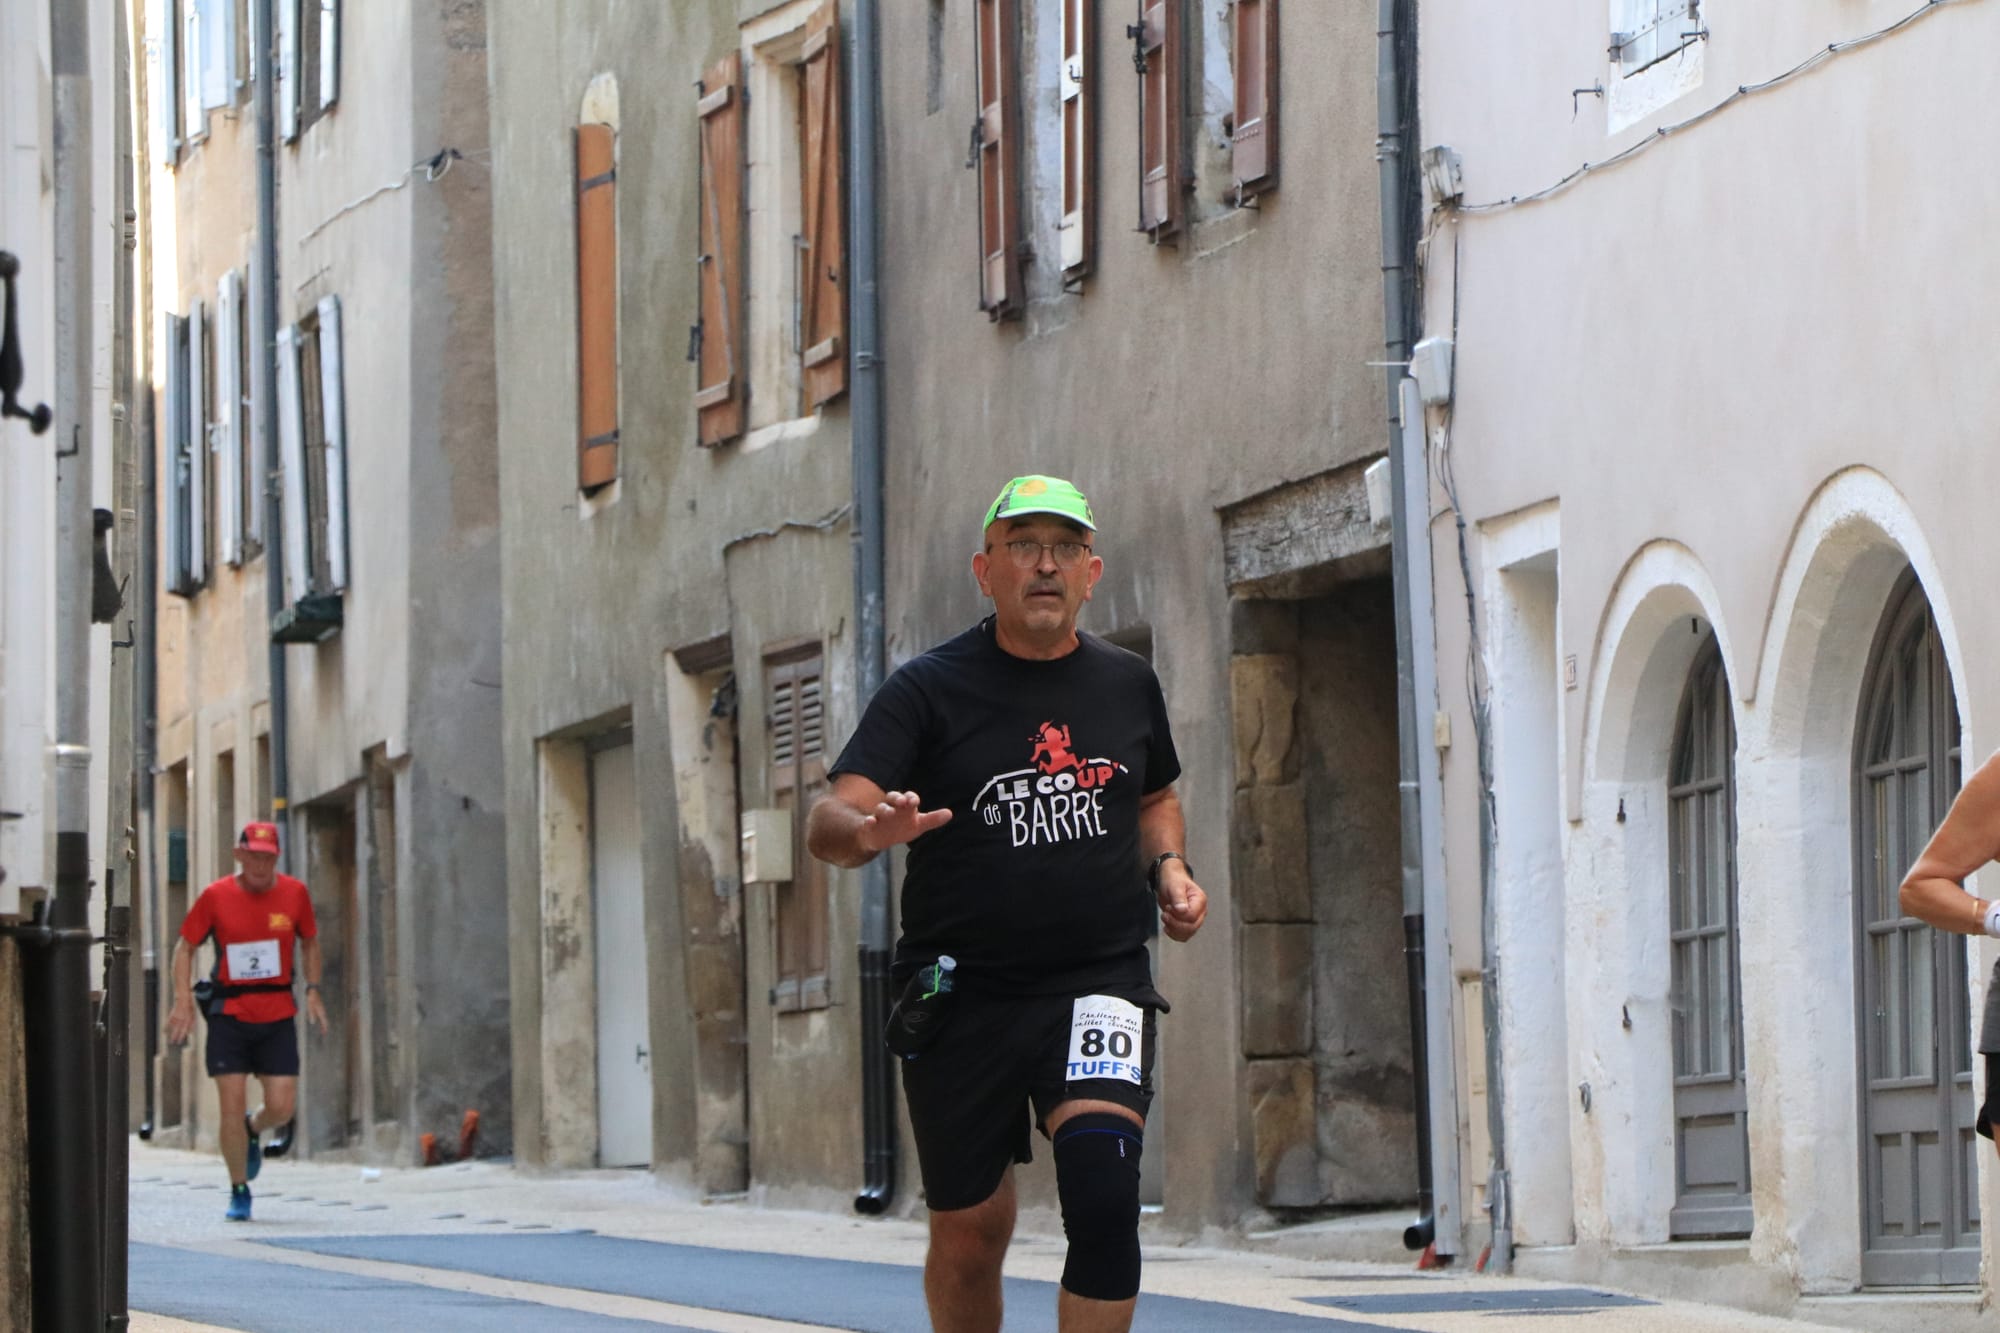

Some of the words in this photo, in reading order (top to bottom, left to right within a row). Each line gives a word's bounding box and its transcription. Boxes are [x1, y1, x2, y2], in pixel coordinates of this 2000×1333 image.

[996, 779, 1031, 801] LE
[1036, 766, 1113, 794] COUP
[984, 803, 1002, 826] de
[1009, 788, 1107, 847] BARRE
[249, 957, 260, 970] 2
[1080, 1012, 1121, 1021] Challenge
[1080, 1028, 1133, 1059] 80
[1067, 1060, 1141, 1081] TUFF'S
